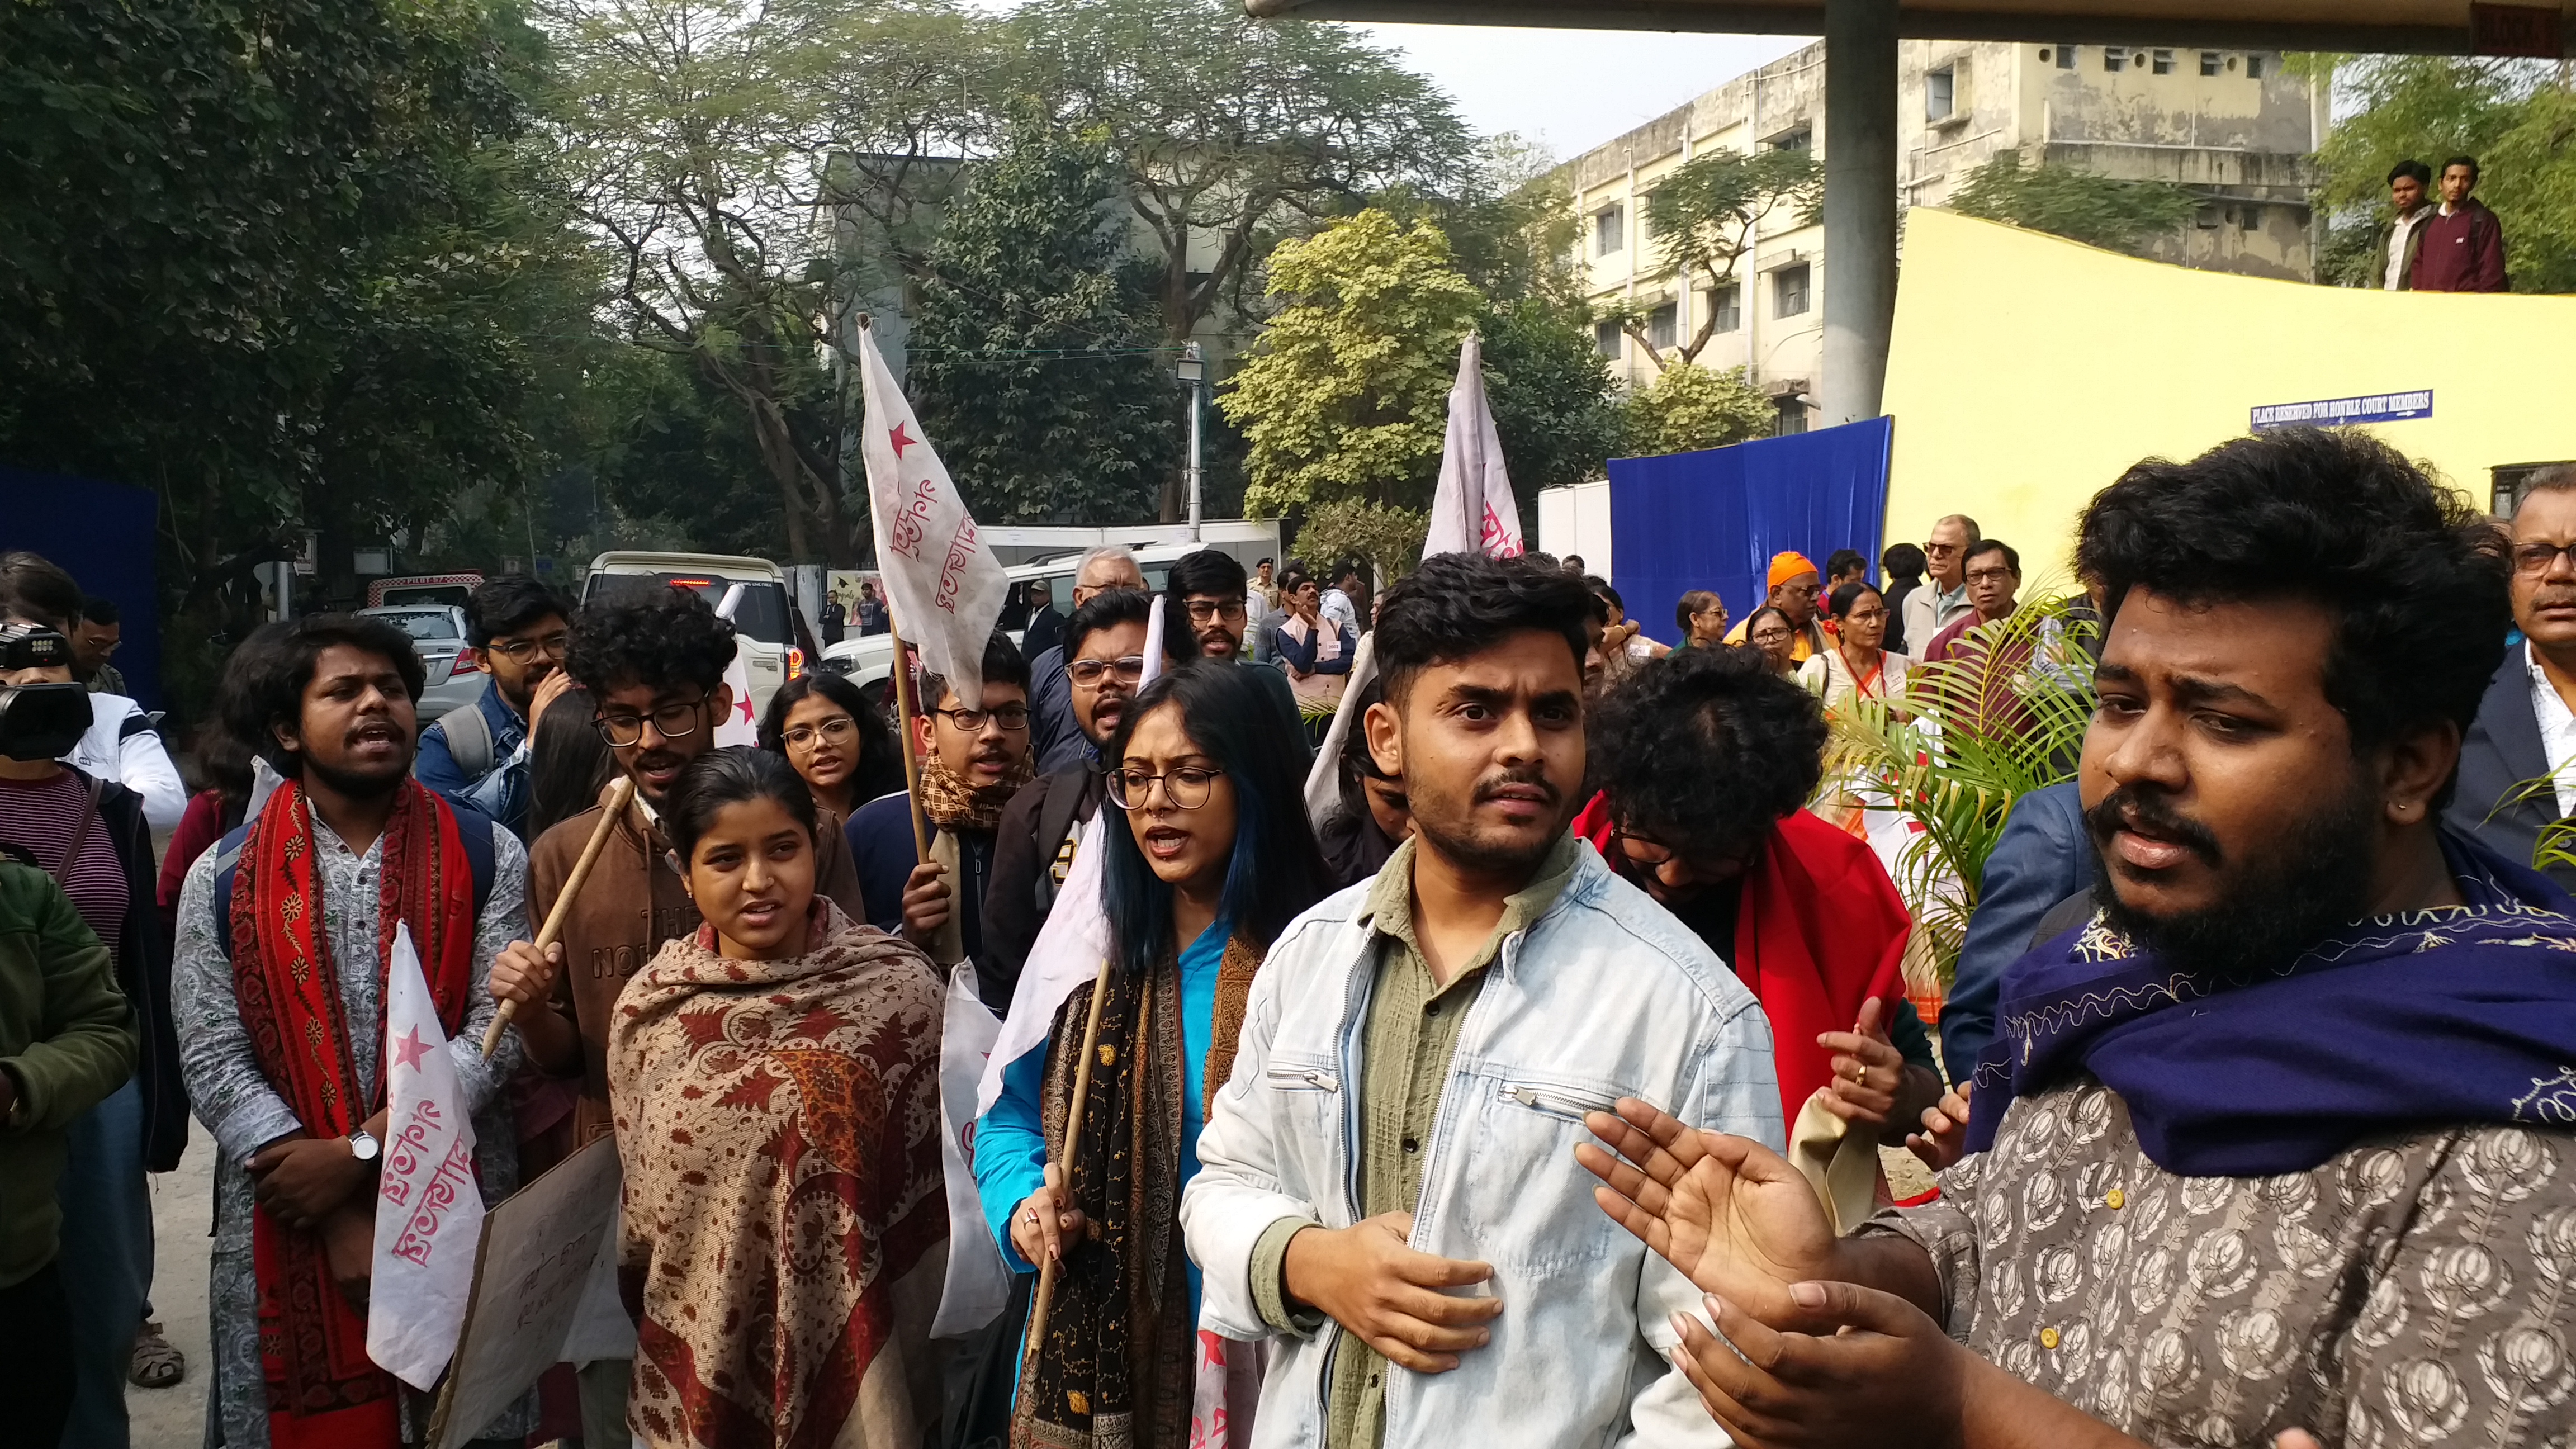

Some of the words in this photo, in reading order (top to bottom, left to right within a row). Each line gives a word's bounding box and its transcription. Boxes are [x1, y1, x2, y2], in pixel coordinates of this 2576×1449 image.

[2252, 408, 2274, 424] PLACE
[2275, 404, 2312, 421] RESERVED
[2313, 401, 2328, 418] FOR
[2361, 396, 2388, 415] COURT
[2388, 392, 2430, 412] MEMBERS
